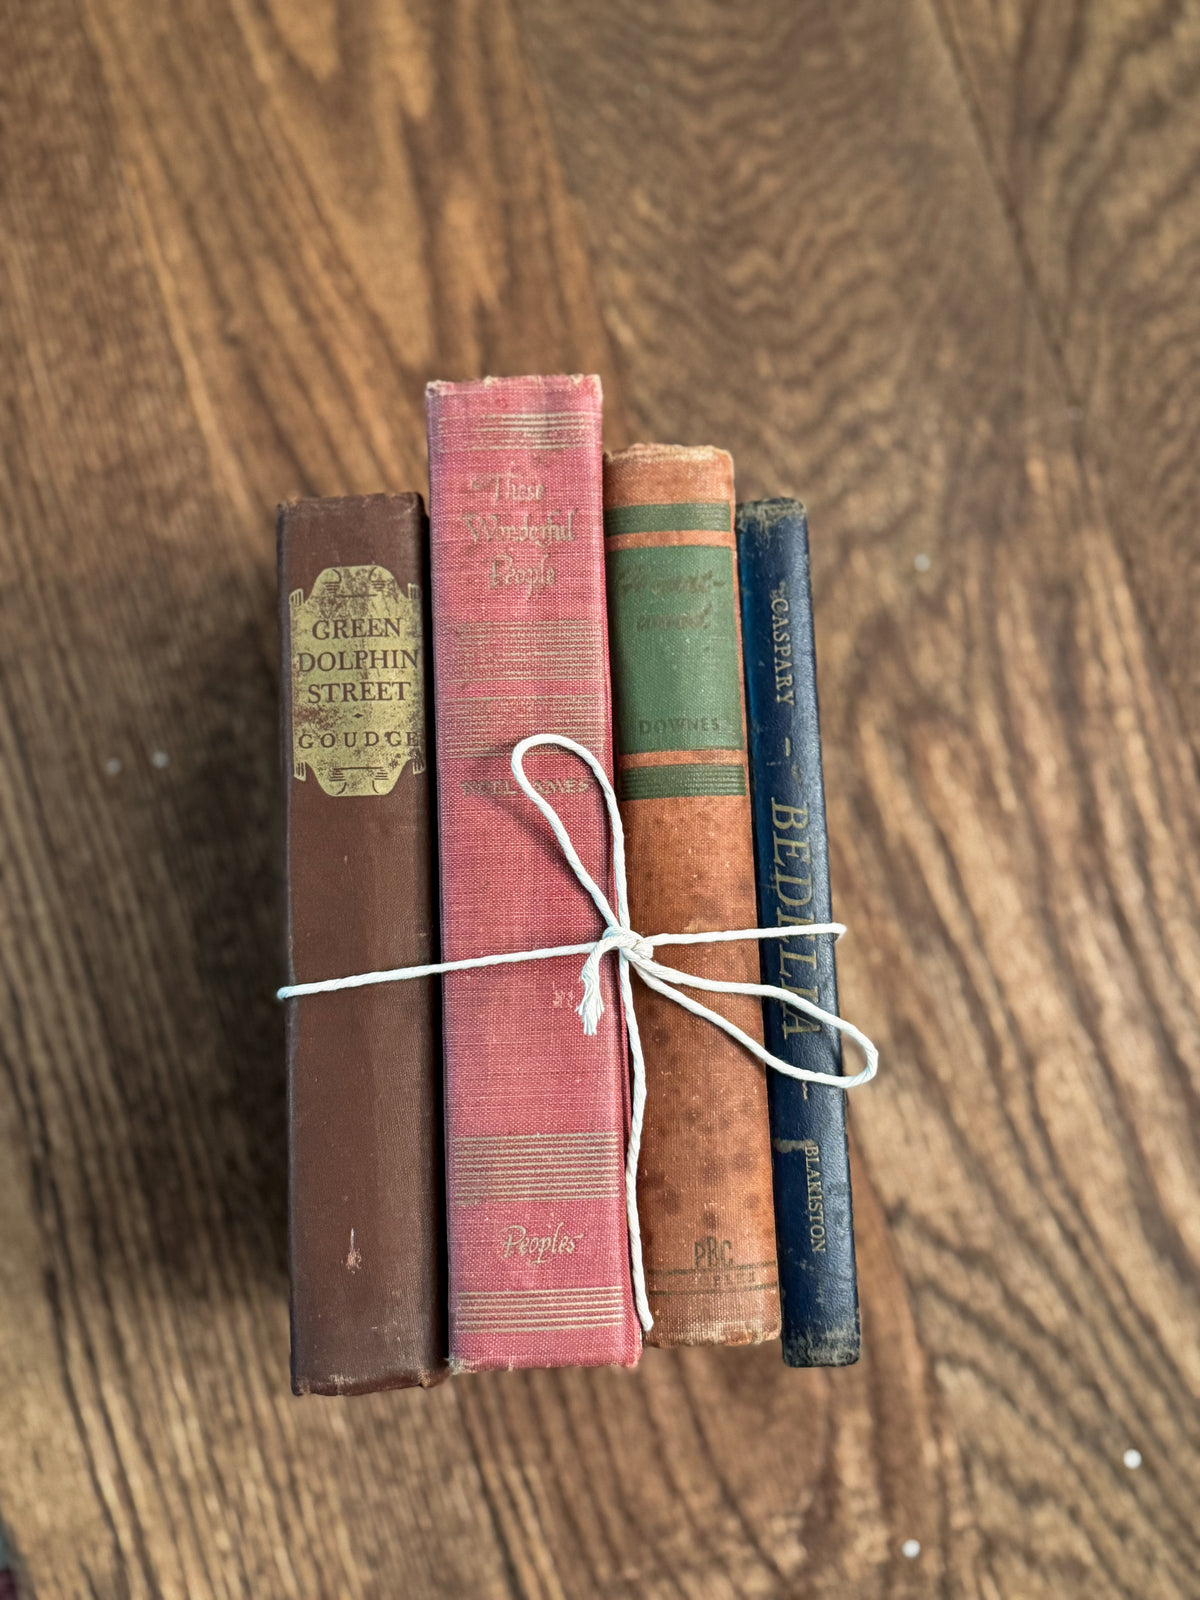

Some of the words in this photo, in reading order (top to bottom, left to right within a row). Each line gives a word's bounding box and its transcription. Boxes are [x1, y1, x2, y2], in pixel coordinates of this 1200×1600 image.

[482, 552, 556, 601] People
[311, 617, 402, 641] GREEN
[298, 648, 419, 673] DOLPHIN
[770, 598, 796, 707] CASPARY
[307, 681, 411, 704] STREET
[298, 731, 420, 750] GOUDGE
[639, 717, 721, 736] DOWNES
[771, 796, 821, 1040] BEDELIA
[804, 1144, 826, 1253] BLAKISTON
[499, 1222, 584, 1266] Peoples
[694, 1236, 734, 1271] PBC
